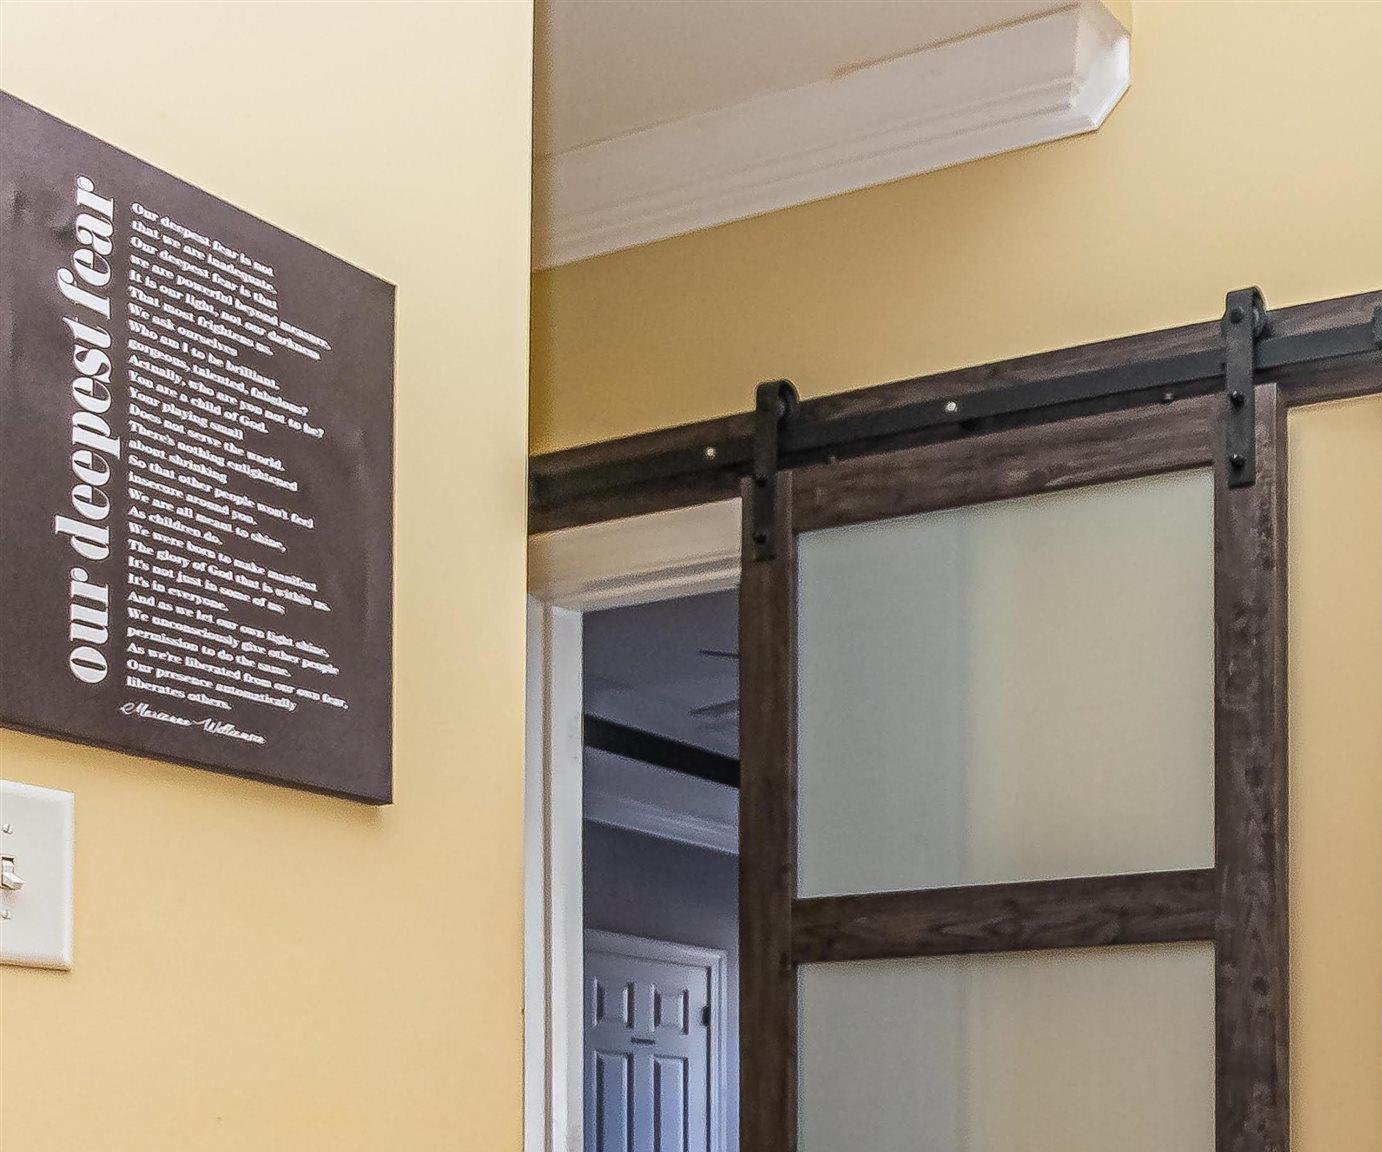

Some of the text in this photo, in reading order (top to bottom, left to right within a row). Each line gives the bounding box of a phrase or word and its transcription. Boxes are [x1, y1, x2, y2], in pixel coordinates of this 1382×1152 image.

[131, 202, 274, 277] Our deepest fear is not
[131, 220, 160, 239] that
[162, 234, 181, 249] we
[182, 244, 205, 260] are
[129, 236, 278, 310] Our deepest fear is that
[130, 254, 149, 269] we
[151, 264, 174, 279] are
[176, 274, 232, 305] powerful
[234, 297, 278, 326] beyond
[127, 285, 160, 307] That
[161, 302, 195, 322] most
[197, 315, 254, 347] frightens
[127, 302, 237, 356] We ask ourselves
[128, 269, 320, 360] It is our light, not our darkness
[127, 338, 191, 372] gorgeous,
[128, 319, 158, 339] Who
[159, 335, 180, 349] am
[181, 341, 188, 352] I
[190, 347, 205, 359] to
[207, 352, 224, 367] be
[128, 369, 154, 388] You
[155, 383, 177, 397] are
[178, 393, 189, 402] a
[189, 397, 221, 415] child
[223, 410, 239, 421] of
[128, 354, 324, 438] Actually, who are you not to be?
[129, 385, 243, 440] Your playing small
[55, 175, 121, 684] our deepest fear
[128, 403, 162, 424] Does
[163, 419, 186, 434] not
[186, 429, 221, 447] serve
[223, 441, 244, 455] the
[128, 439, 227, 484] about shrinking
[177, 441, 225, 467] nothing
[226, 460, 297, 491] enlightened
[127, 454, 146, 468] So
[148, 462, 176, 479] that
[177, 474, 212, 492] other
[213, 487, 255, 507] people
[290, 512, 313, 528] feel
[127, 487, 149, 503] We
[151, 498, 174, 511] are
[175, 506, 193, 518] all
[195, 513, 234, 532] meant
[234, 526, 249, 538] to
[128, 470, 183, 498] insecure
[185, 493, 229, 515] around
[127, 505, 146, 519] As
[147, 513, 202, 537] children
[127, 538, 154, 555] The
[156, 549, 190, 567] glory
[191, 561, 207, 571] of
[207, 564, 233, 580] God
[234, 574, 260, 589] that
[261, 581, 273, 593] is
[274, 587, 312, 605] within
[128, 521, 317, 592] We were born to make manifest
[151, 565, 175, 578] not
[175, 570, 203, 587] just
[204, 578, 218, 591] in
[218, 586, 250, 602] some
[251, 597, 267, 606] of
[151, 579, 165, 592] in
[127, 591, 155, 606] And
[156, 601, 173, 611] as
[175, 605, 194, 617] we
[195, 609, 214, 623] let
[215, 618, 238, 630] our
[239, 625, 265, 638] own
[266, 630, 294, 646] light
[127, 606, 339, 675] We unconsciously give other people
[126, 626, 198, 651] permission
[201, 645, 215, 656] to
[216, 649, 234, 661] do
[234, 654, 255, 667] the
[126, 642, 145, 654] As
[184, 655, 241, 680] liberated
[242, 672, 272, 687] from
[273, 682, 295, 693] our
[295, 688, 320, 700] own
[126, 658, 296, 711] Our presence automatically
[126, 675, 185, 698] liberates
